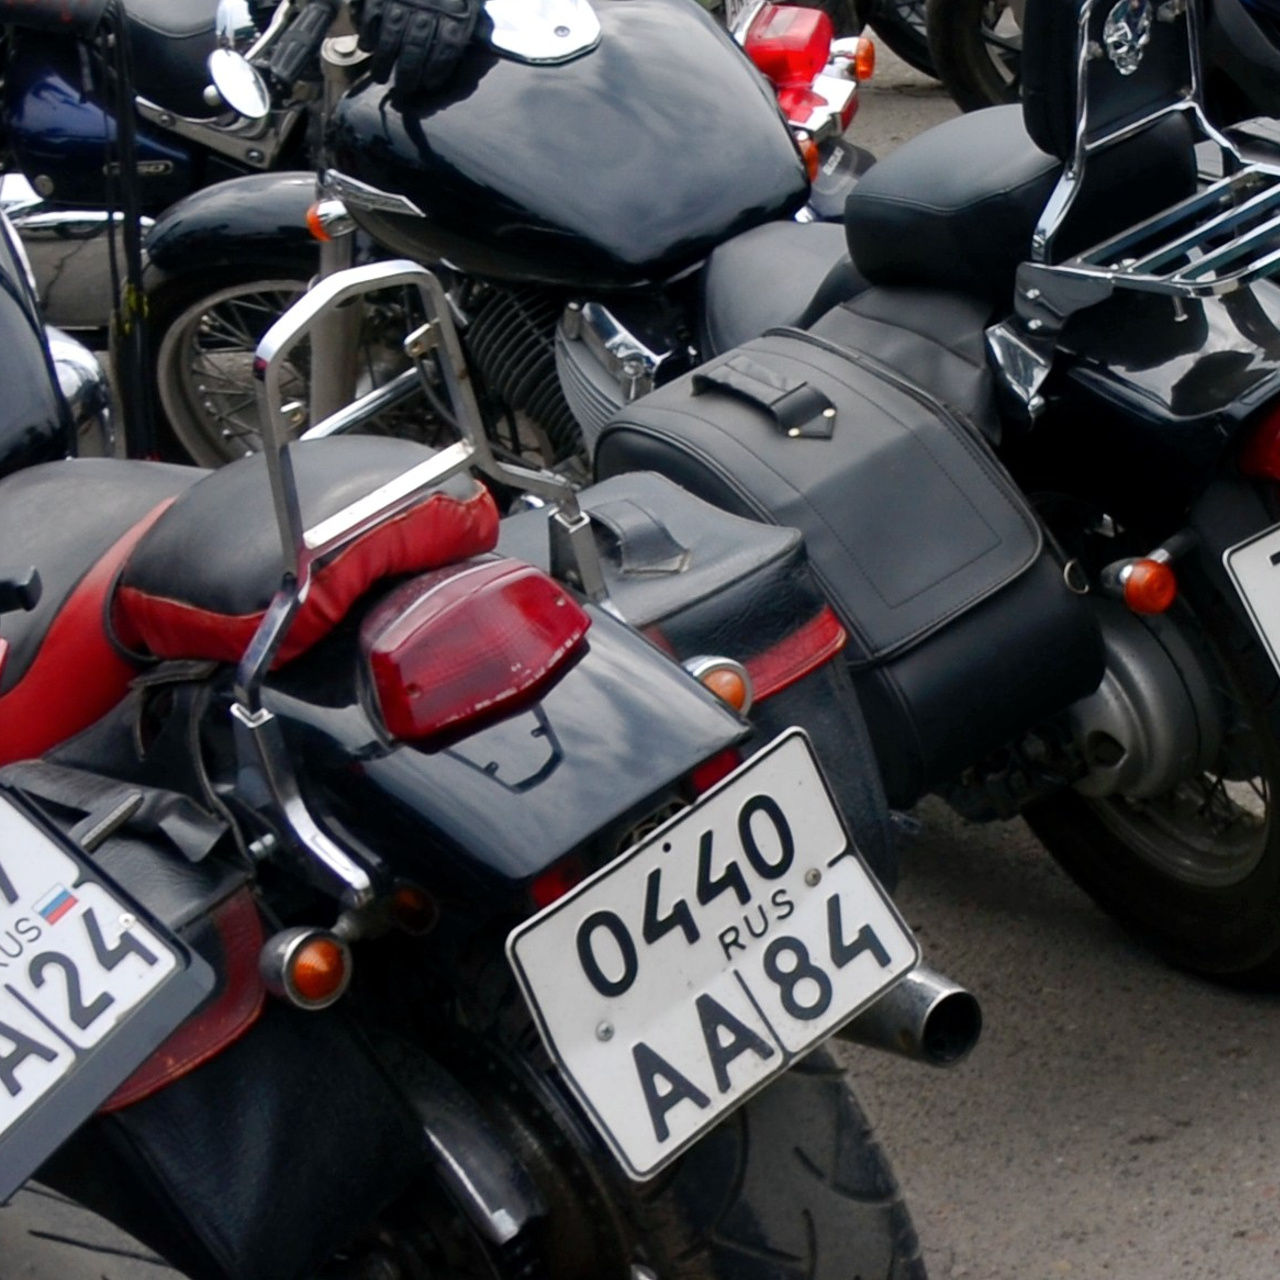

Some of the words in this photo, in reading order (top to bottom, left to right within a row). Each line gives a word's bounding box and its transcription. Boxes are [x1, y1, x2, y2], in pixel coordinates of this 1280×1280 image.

[0, 917, 42, 969] US
[576, 793, 795, 998] 0440
[717, 888, 795, 961] RUS
[28, 906, 159, 1030] 24
[0, 1023, 58, 1098] A
[631, 992, 775, 1144] AA
[762, 892, 892, 1021] 84
